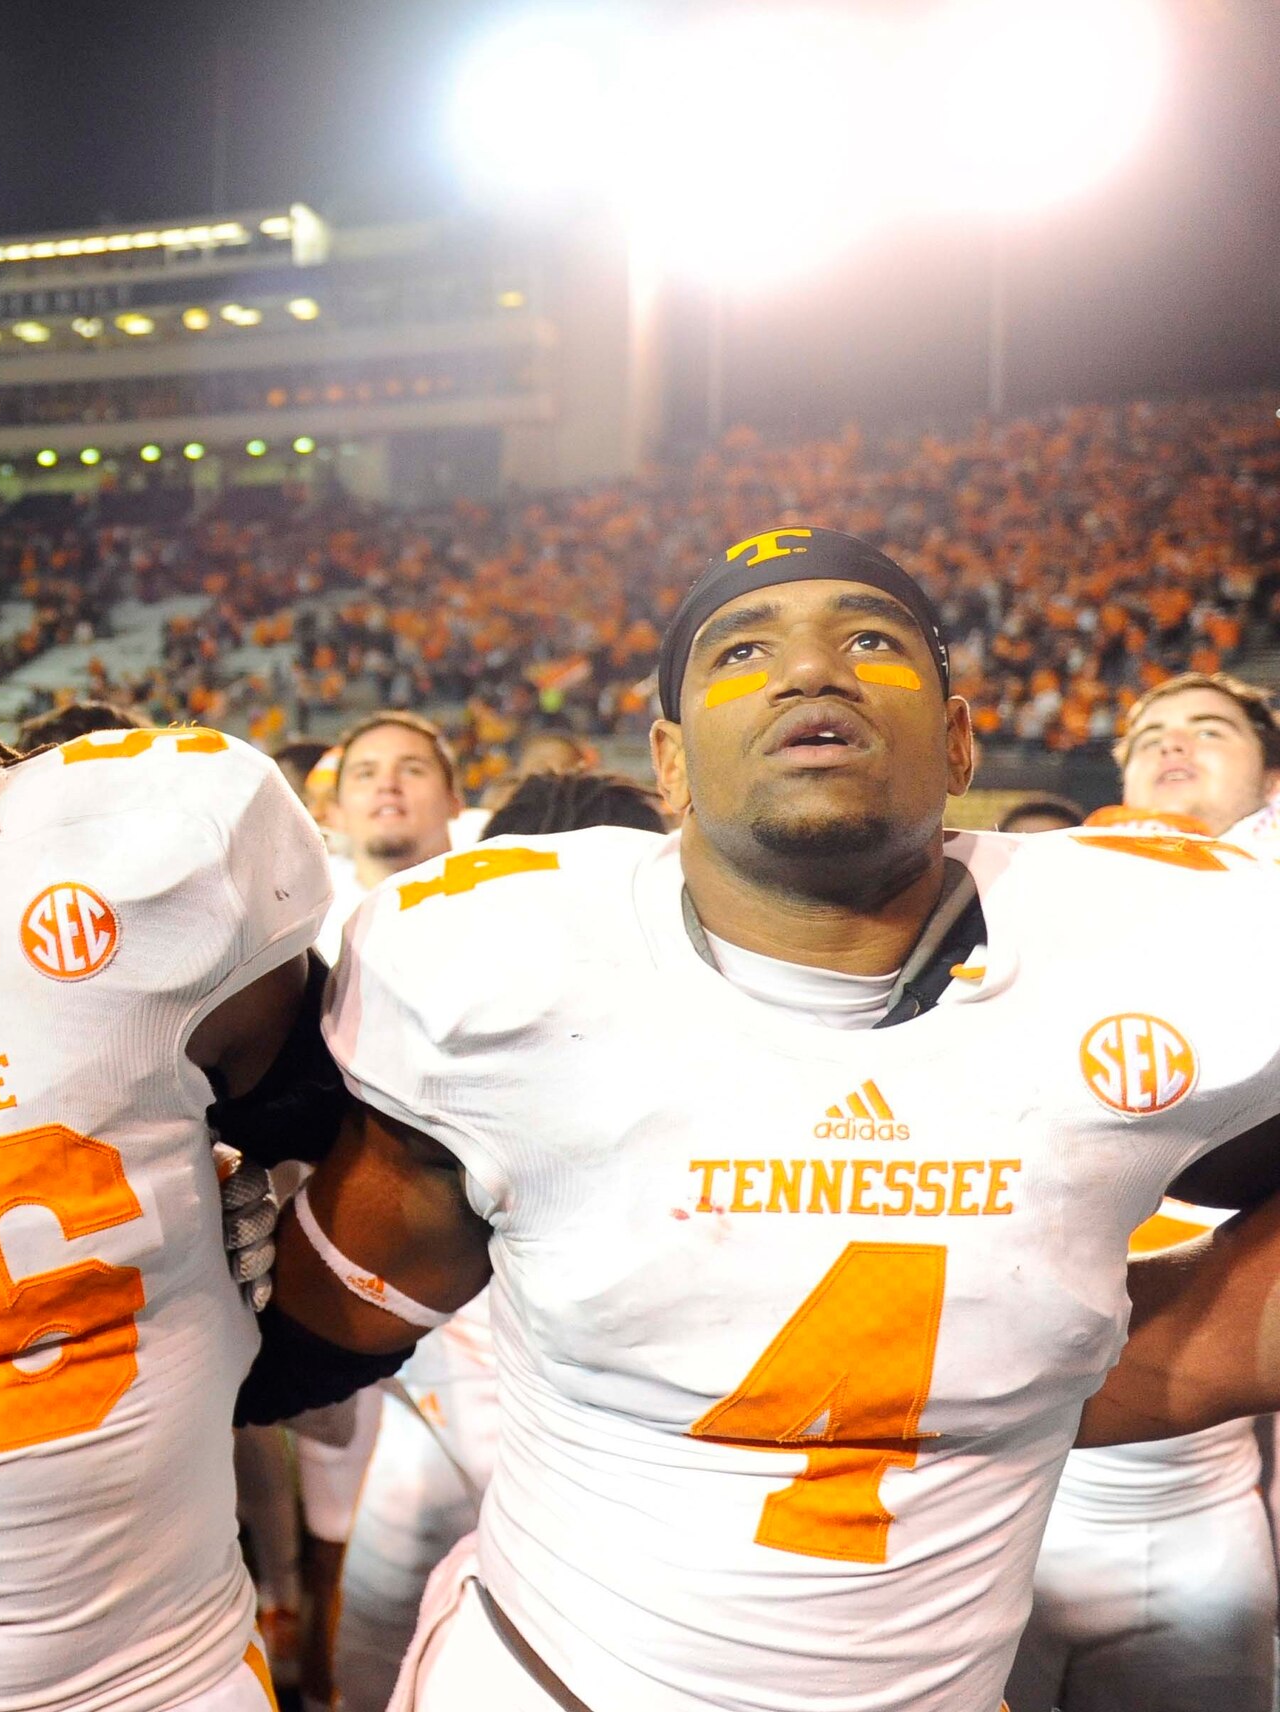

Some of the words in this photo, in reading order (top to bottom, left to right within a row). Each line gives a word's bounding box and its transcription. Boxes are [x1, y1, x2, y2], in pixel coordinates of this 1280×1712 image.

[26, 887, 112, 973] SEC
[1085, 1017, 1187, 1109] SEC
[813, 1117, 911, 1141] adidas
[688, 1157, 1023, 1217] TENNESSEE
[683, 1240, 949, 1564] 4
